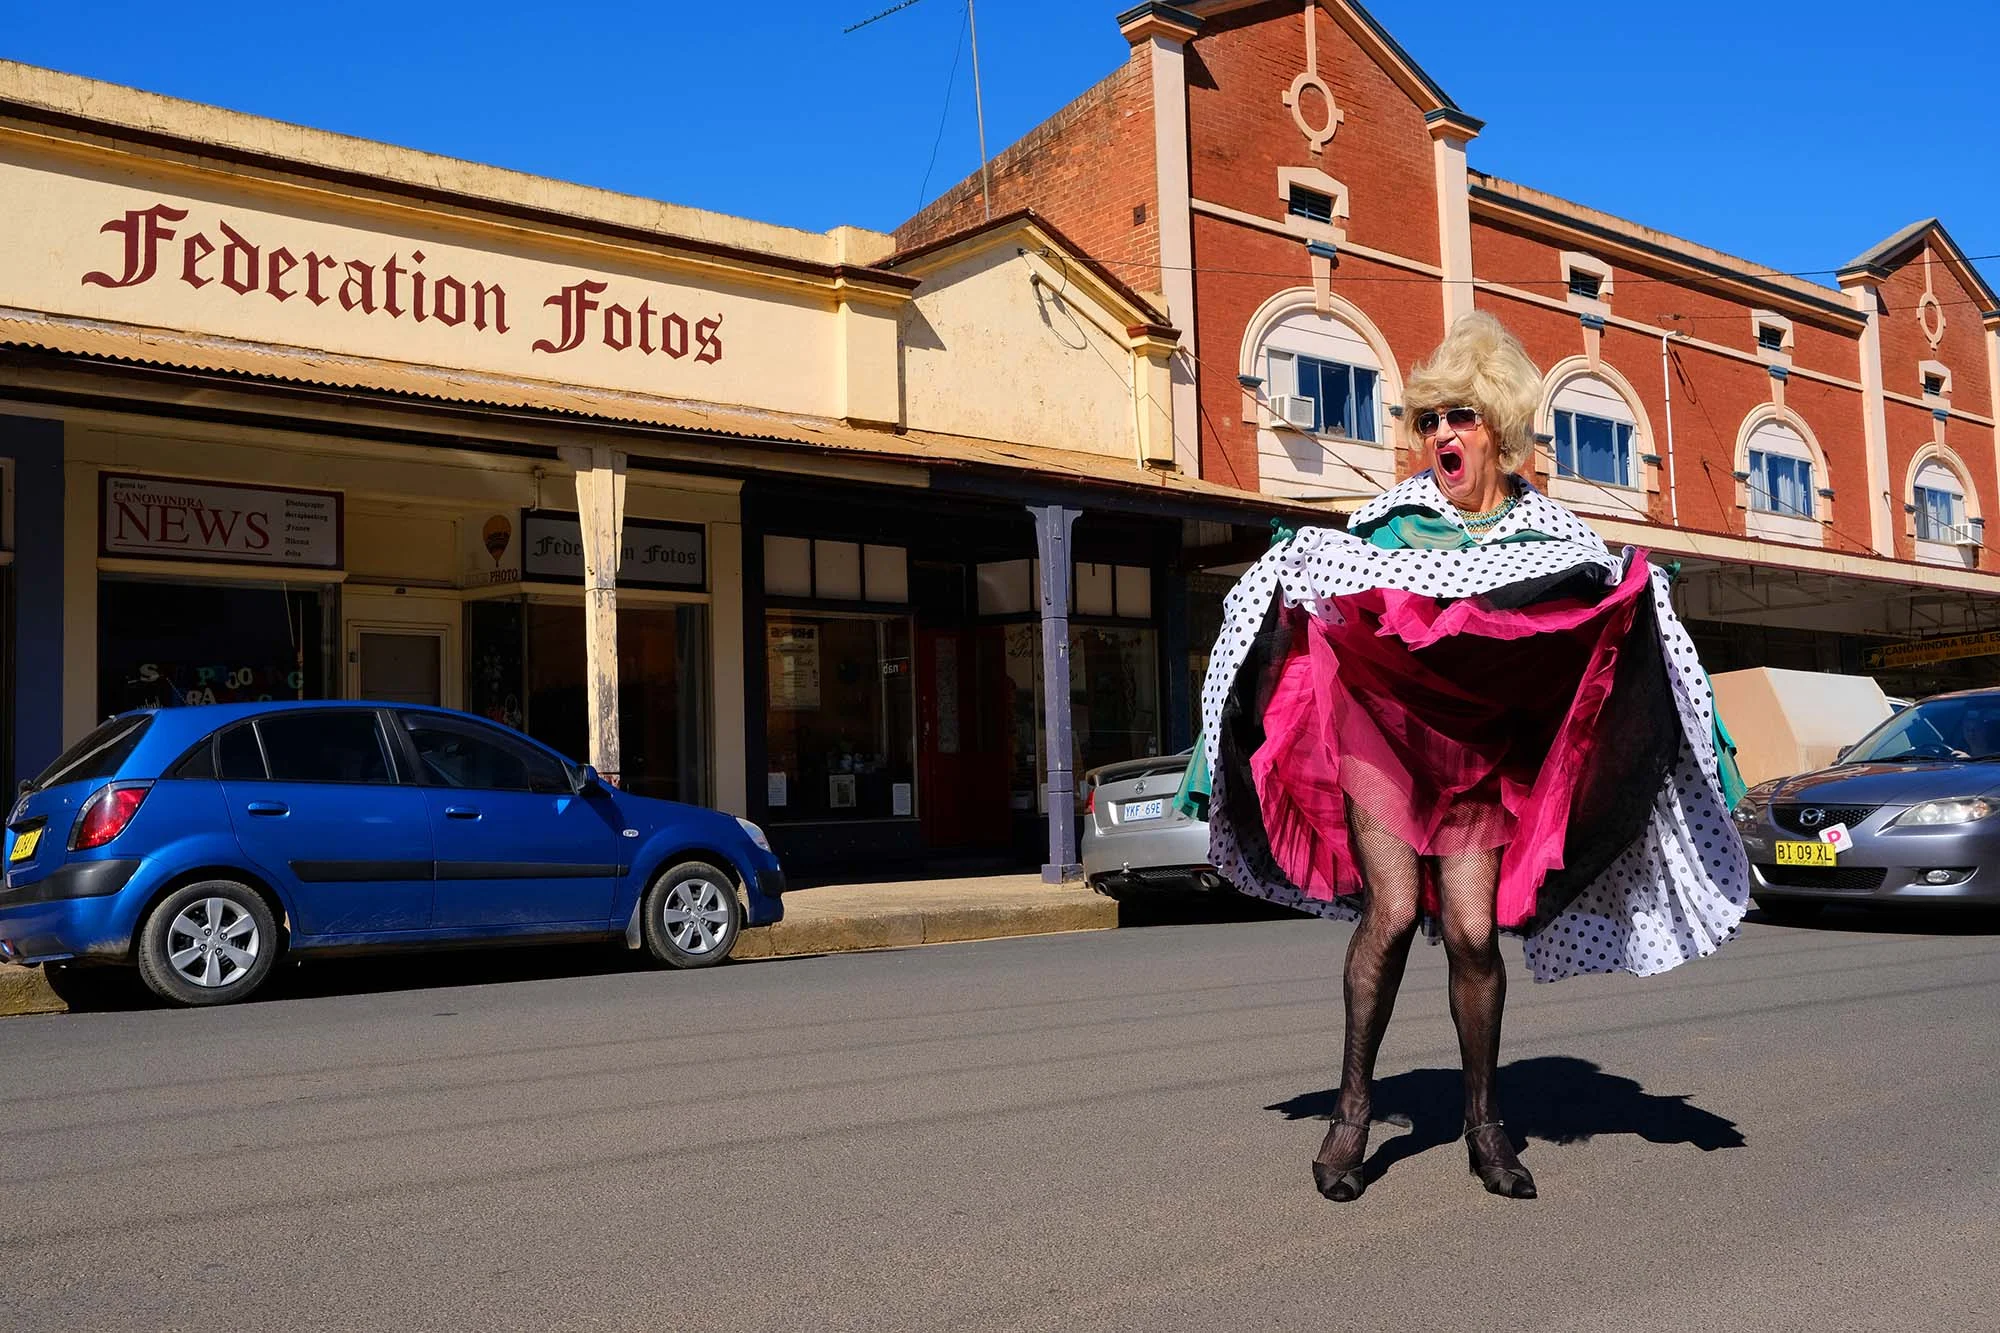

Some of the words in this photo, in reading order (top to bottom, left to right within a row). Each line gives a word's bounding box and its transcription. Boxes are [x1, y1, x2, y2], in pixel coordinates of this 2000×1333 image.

[82, 203, 511, 334] Federation
[532, 279, 725, 365] Fotos
[113, 491, 204, 509] CANOWINDRA
[113, 501, 270, 550] NEWS
[642, 544, 697, 566] Fotos
[489, 567, 518, 584] PHOTO
[1885, 638, 1958, 656] CANOWINDRA
[1960, 634, 1985, 646] REAL
[1125, 804, 1140, 817] YKF
[1144, 801, 1161, 815] 69E
[1777, 844, 1792, 860] BI
[1797, 844, 1812, 860] 09
[1817, 844, 1833, 861] XL
